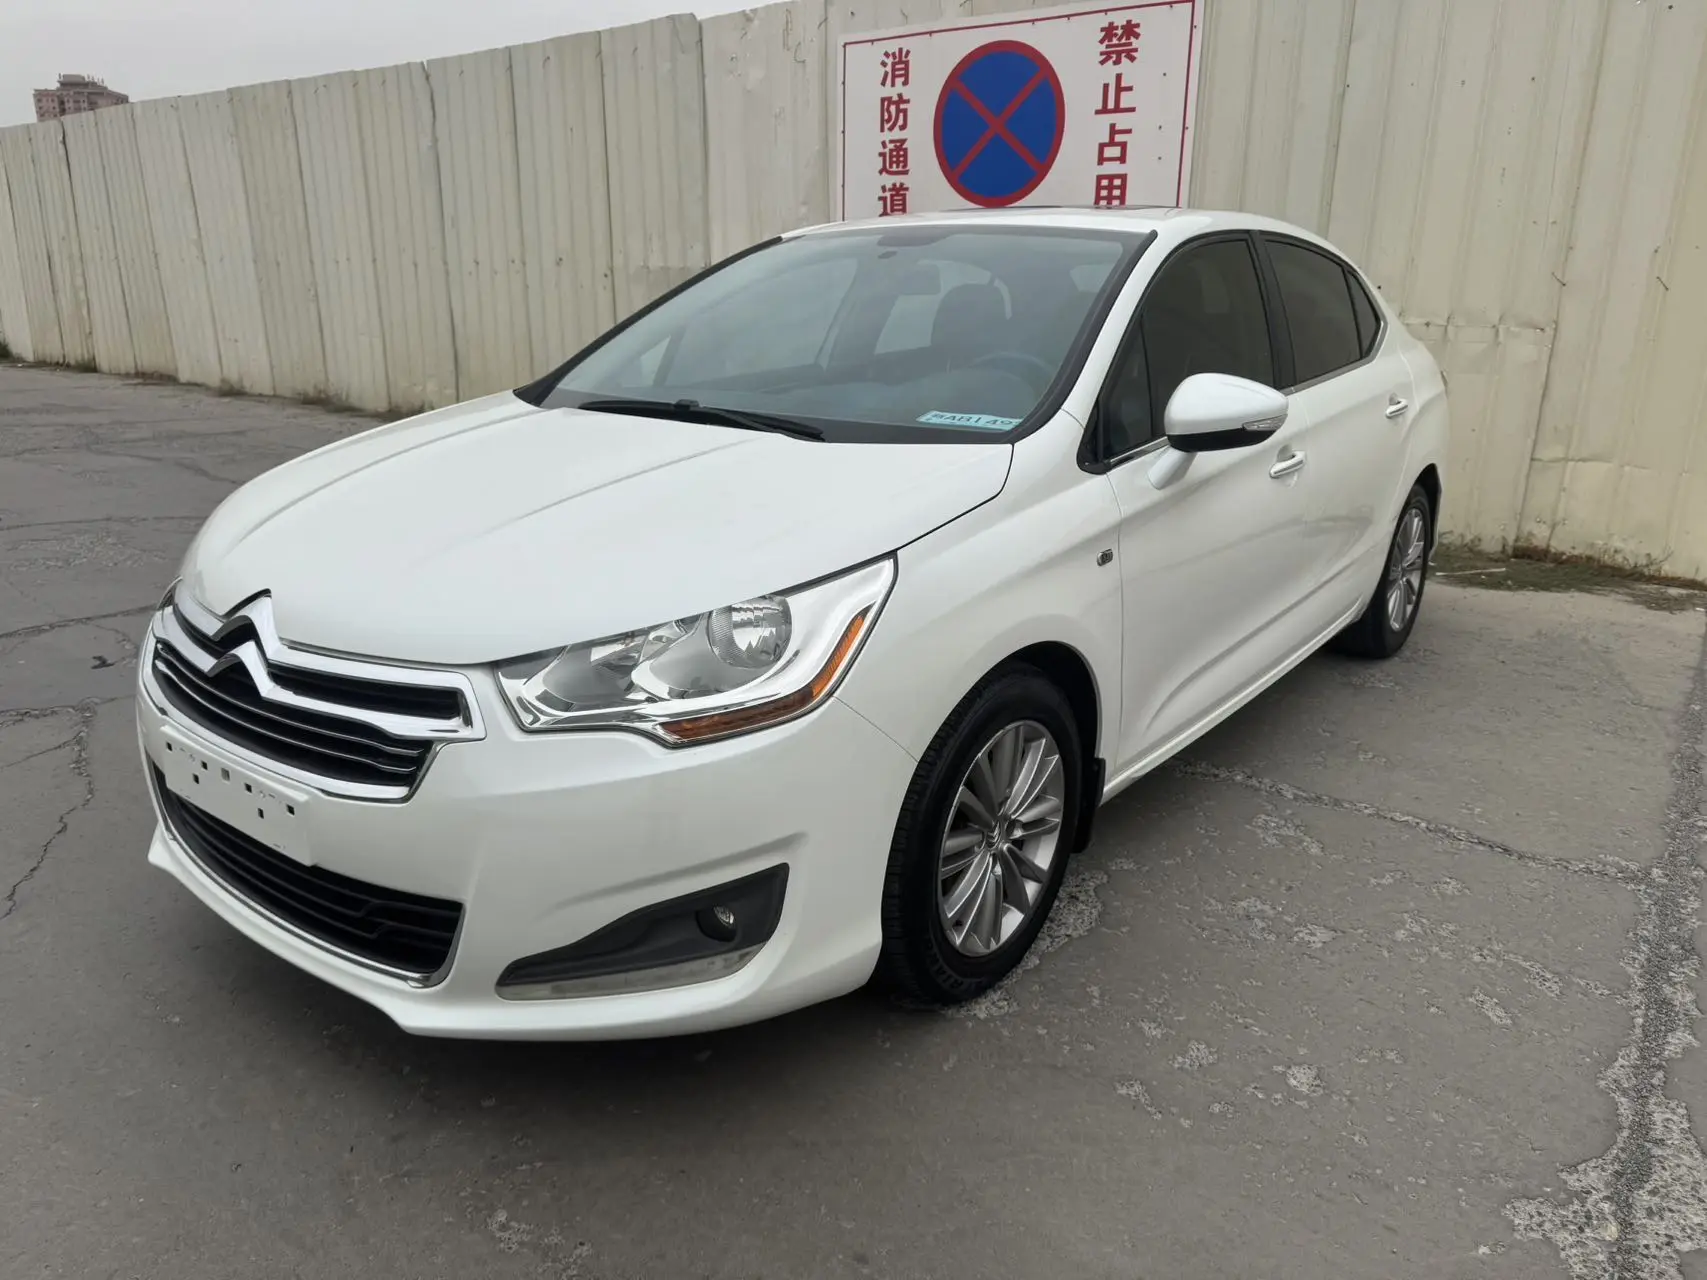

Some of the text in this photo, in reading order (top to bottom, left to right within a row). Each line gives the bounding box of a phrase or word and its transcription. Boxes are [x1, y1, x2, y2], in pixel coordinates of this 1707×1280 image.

[878, 47, 911, 217] 消防通道
[1094, 19, 1141, 206] 禁止占用
